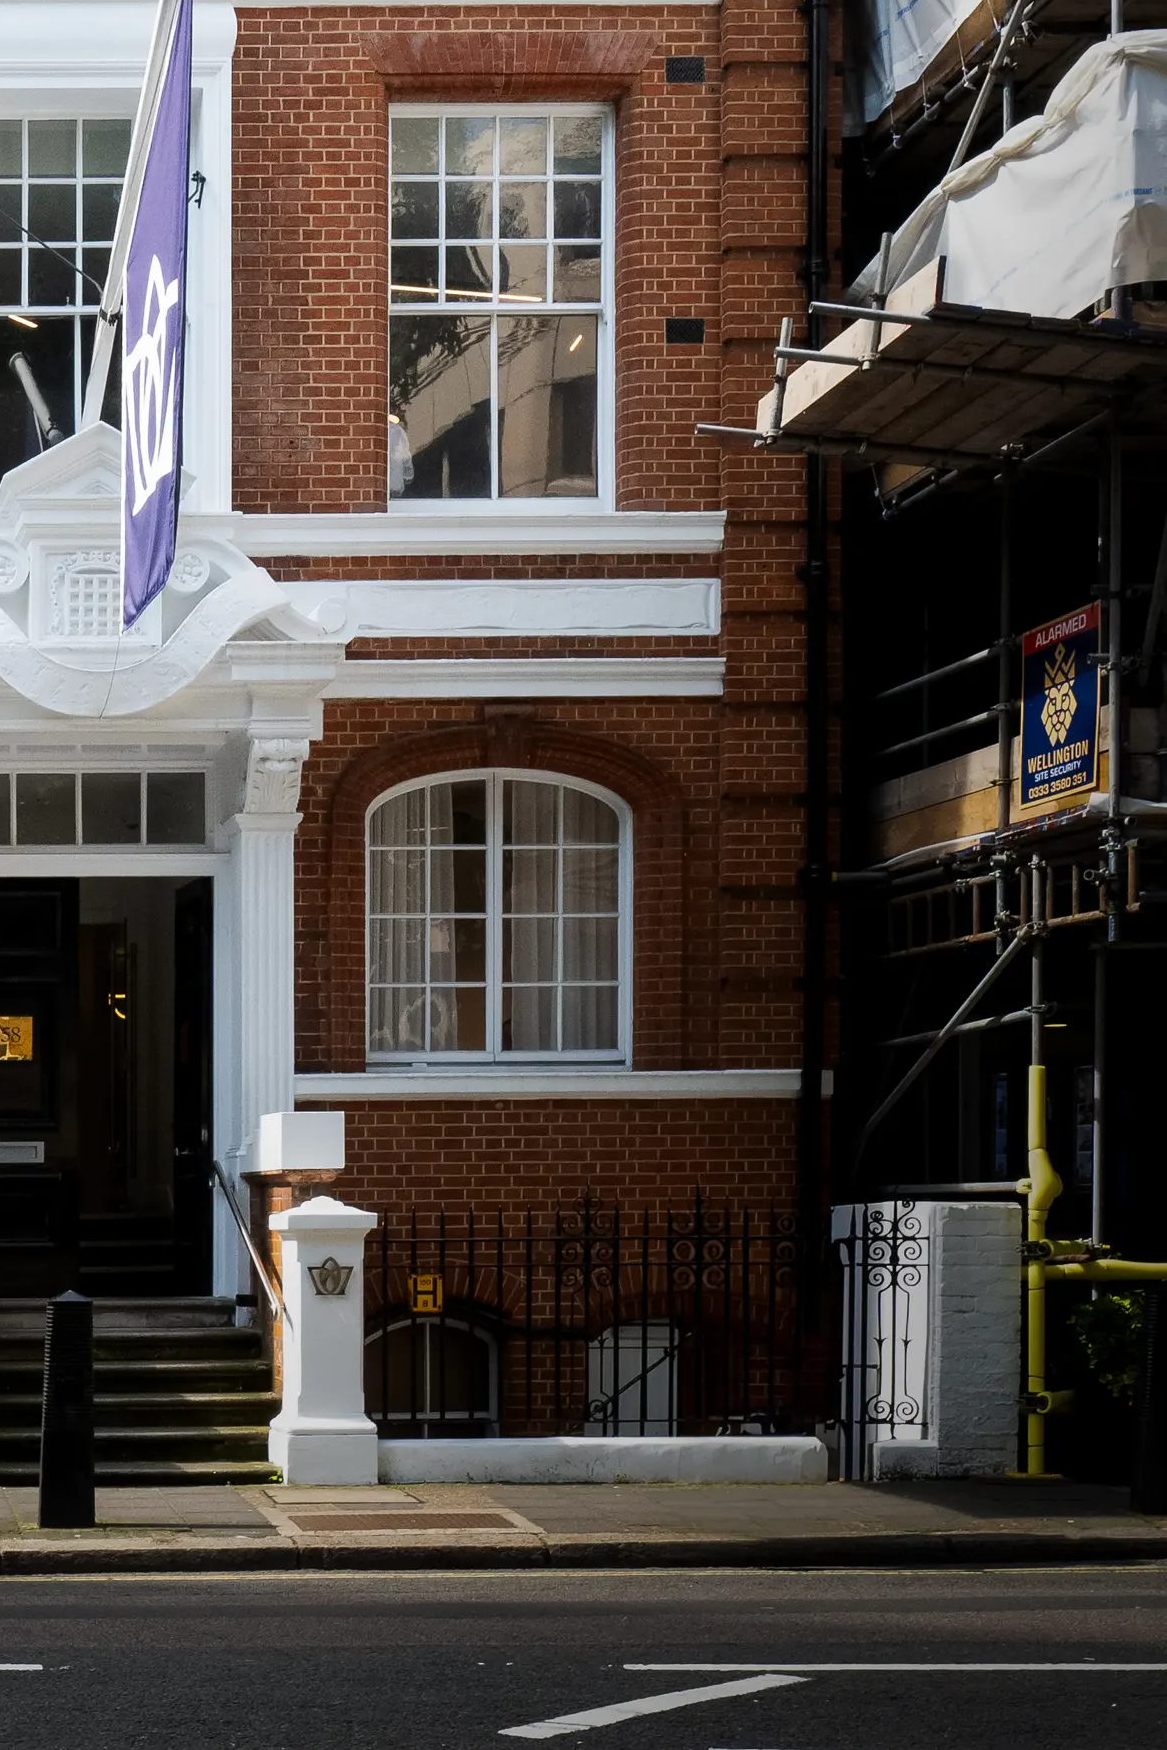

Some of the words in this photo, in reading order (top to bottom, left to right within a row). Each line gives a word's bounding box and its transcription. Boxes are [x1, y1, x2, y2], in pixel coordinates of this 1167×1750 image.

[1035, 613, 1087, 648] ALARMED
[1027, 739, 1089, 774] WELLINGTON
[1028, 783, 1049, 799] 0333
[1050, 776, 1072, 793] 3580
[1072, 771, 1087, 786] 351
[1034, 770, 1049, 783] SITE
[1050, 759, 1082, 778] SECURITY
[0, 1026, 21, 1043] 58
